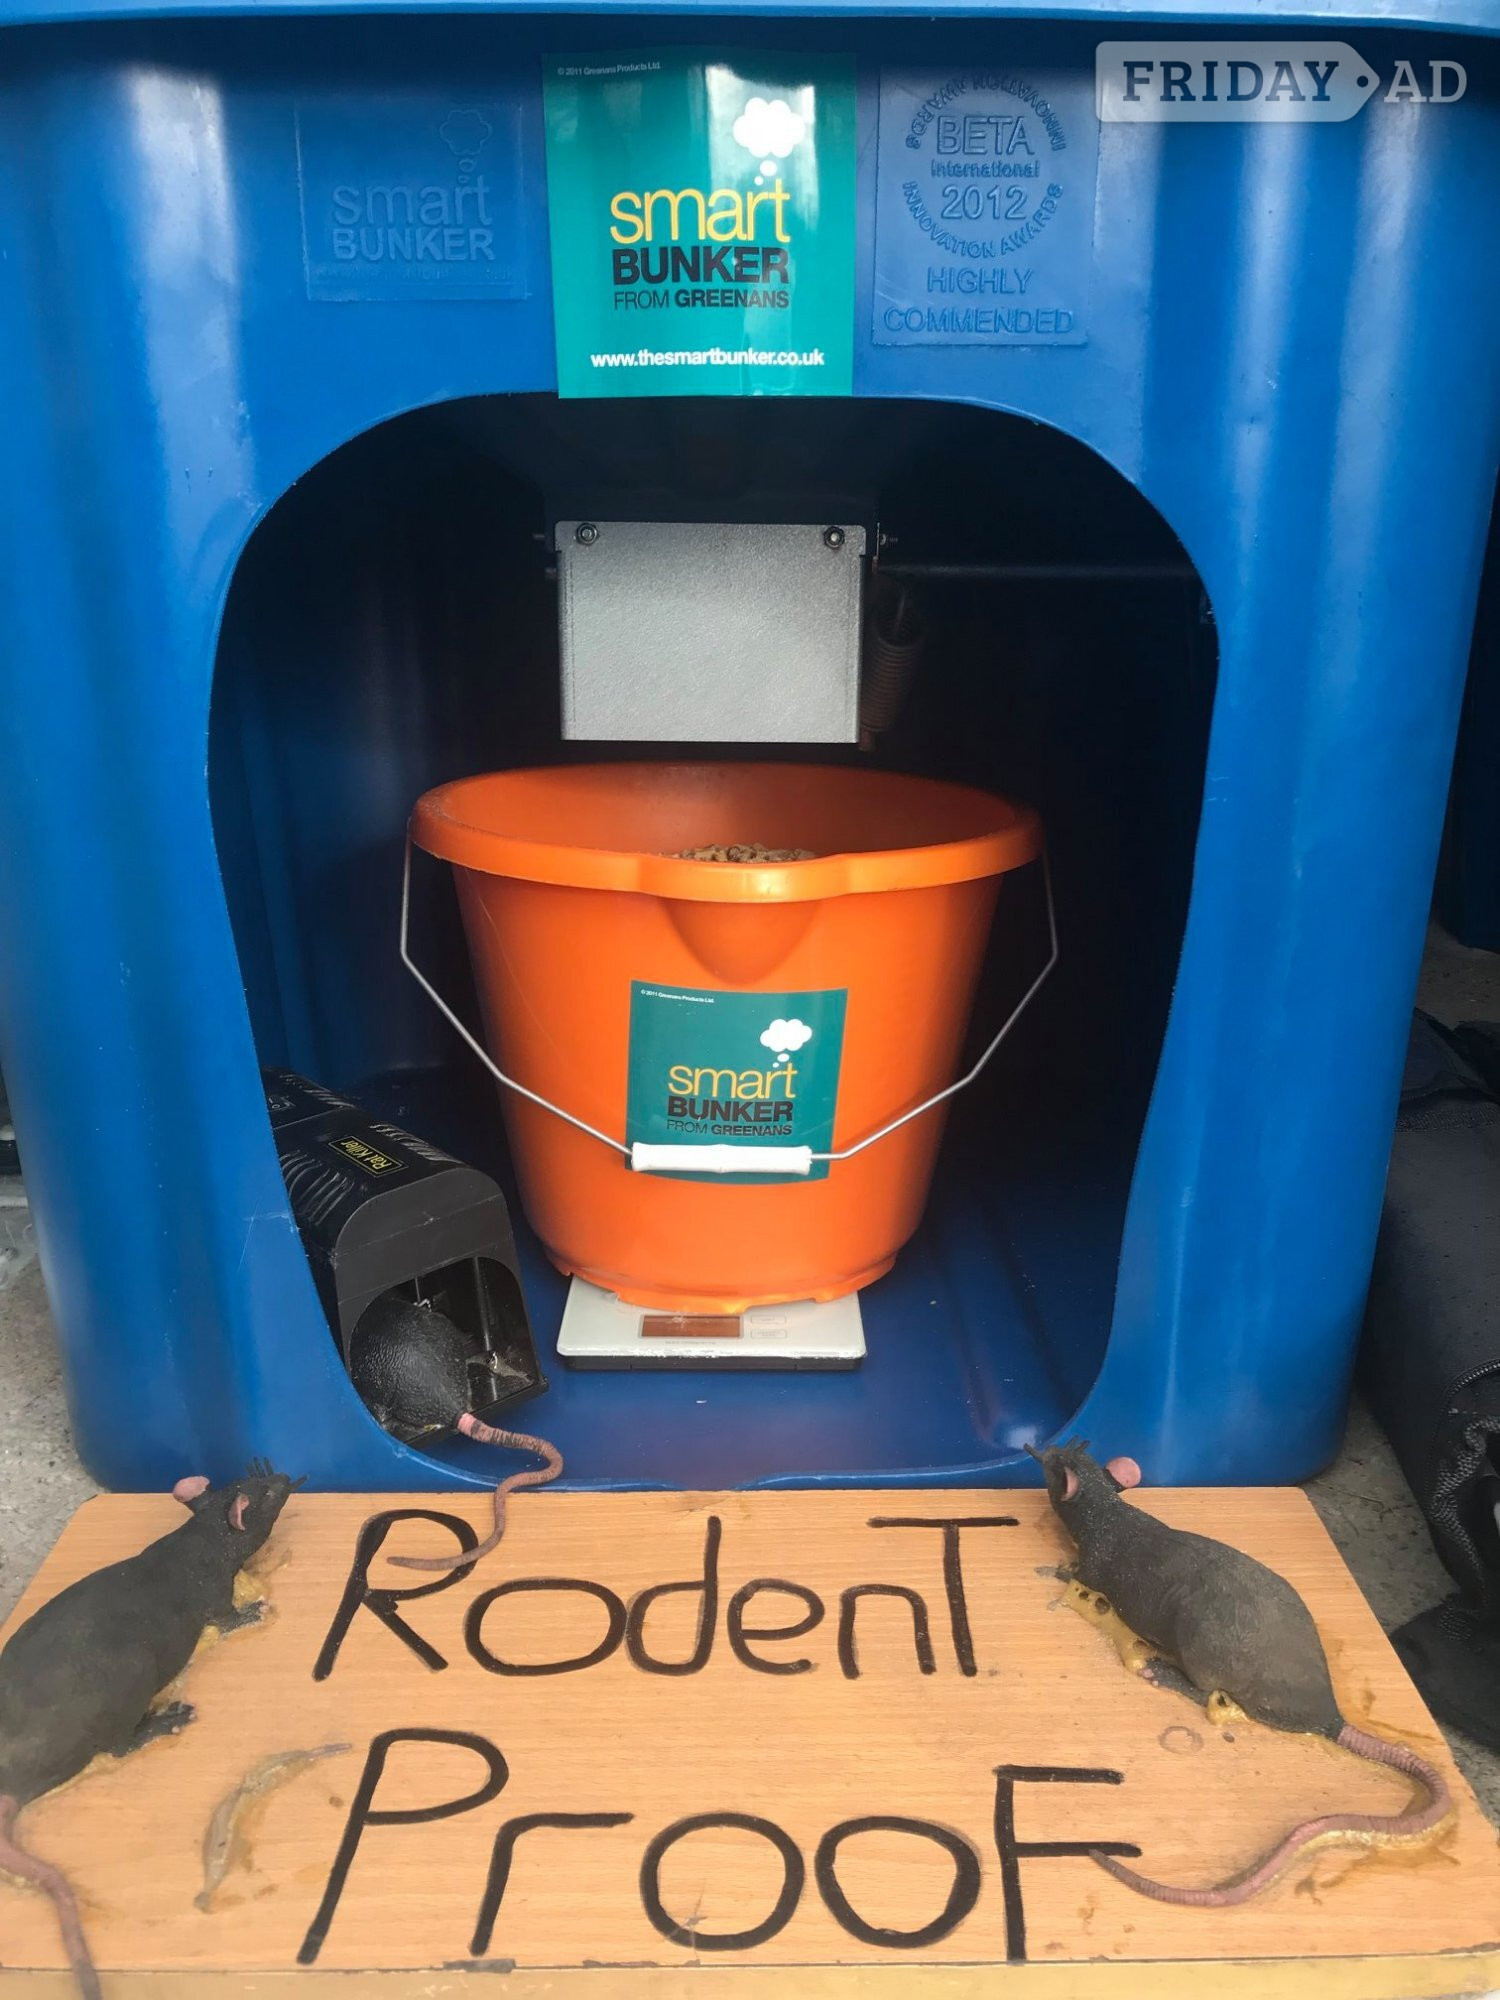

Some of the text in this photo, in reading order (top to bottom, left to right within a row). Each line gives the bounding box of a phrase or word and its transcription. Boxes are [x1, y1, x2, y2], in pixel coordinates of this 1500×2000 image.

[565, 66, 582, 76] 2011
[616, 62, 647, 73] Products
[936, 114, 1036, 156] BETA
[930, 159, 1040, 178] International
[332, 175, 494, 226] smart
[610, 178, 791, 244] smart
[940, 184, 1028, 220] 2012
[902, 181, 1064, 259] INNOVATION AWARDS
[332, 228, 496, 262] BUNKER
[612, 246, 790, 285] BUNKER
[926, 266, 1033, 295] HIGHLY
[614, 289, 790, 310] FROM GREENANS
[883, 306, 1074, 335] COMMENDED
[591, 347, 825, 368] www.thesmartbunker.co.uk
[668, 1063, 798, 1099] smart
[667, 1095, 794, 1122] BUNKER
[666, 1119, 793, 1136] FROM GREENANS
[340, 1140, 392, 1170] Rat Killer
